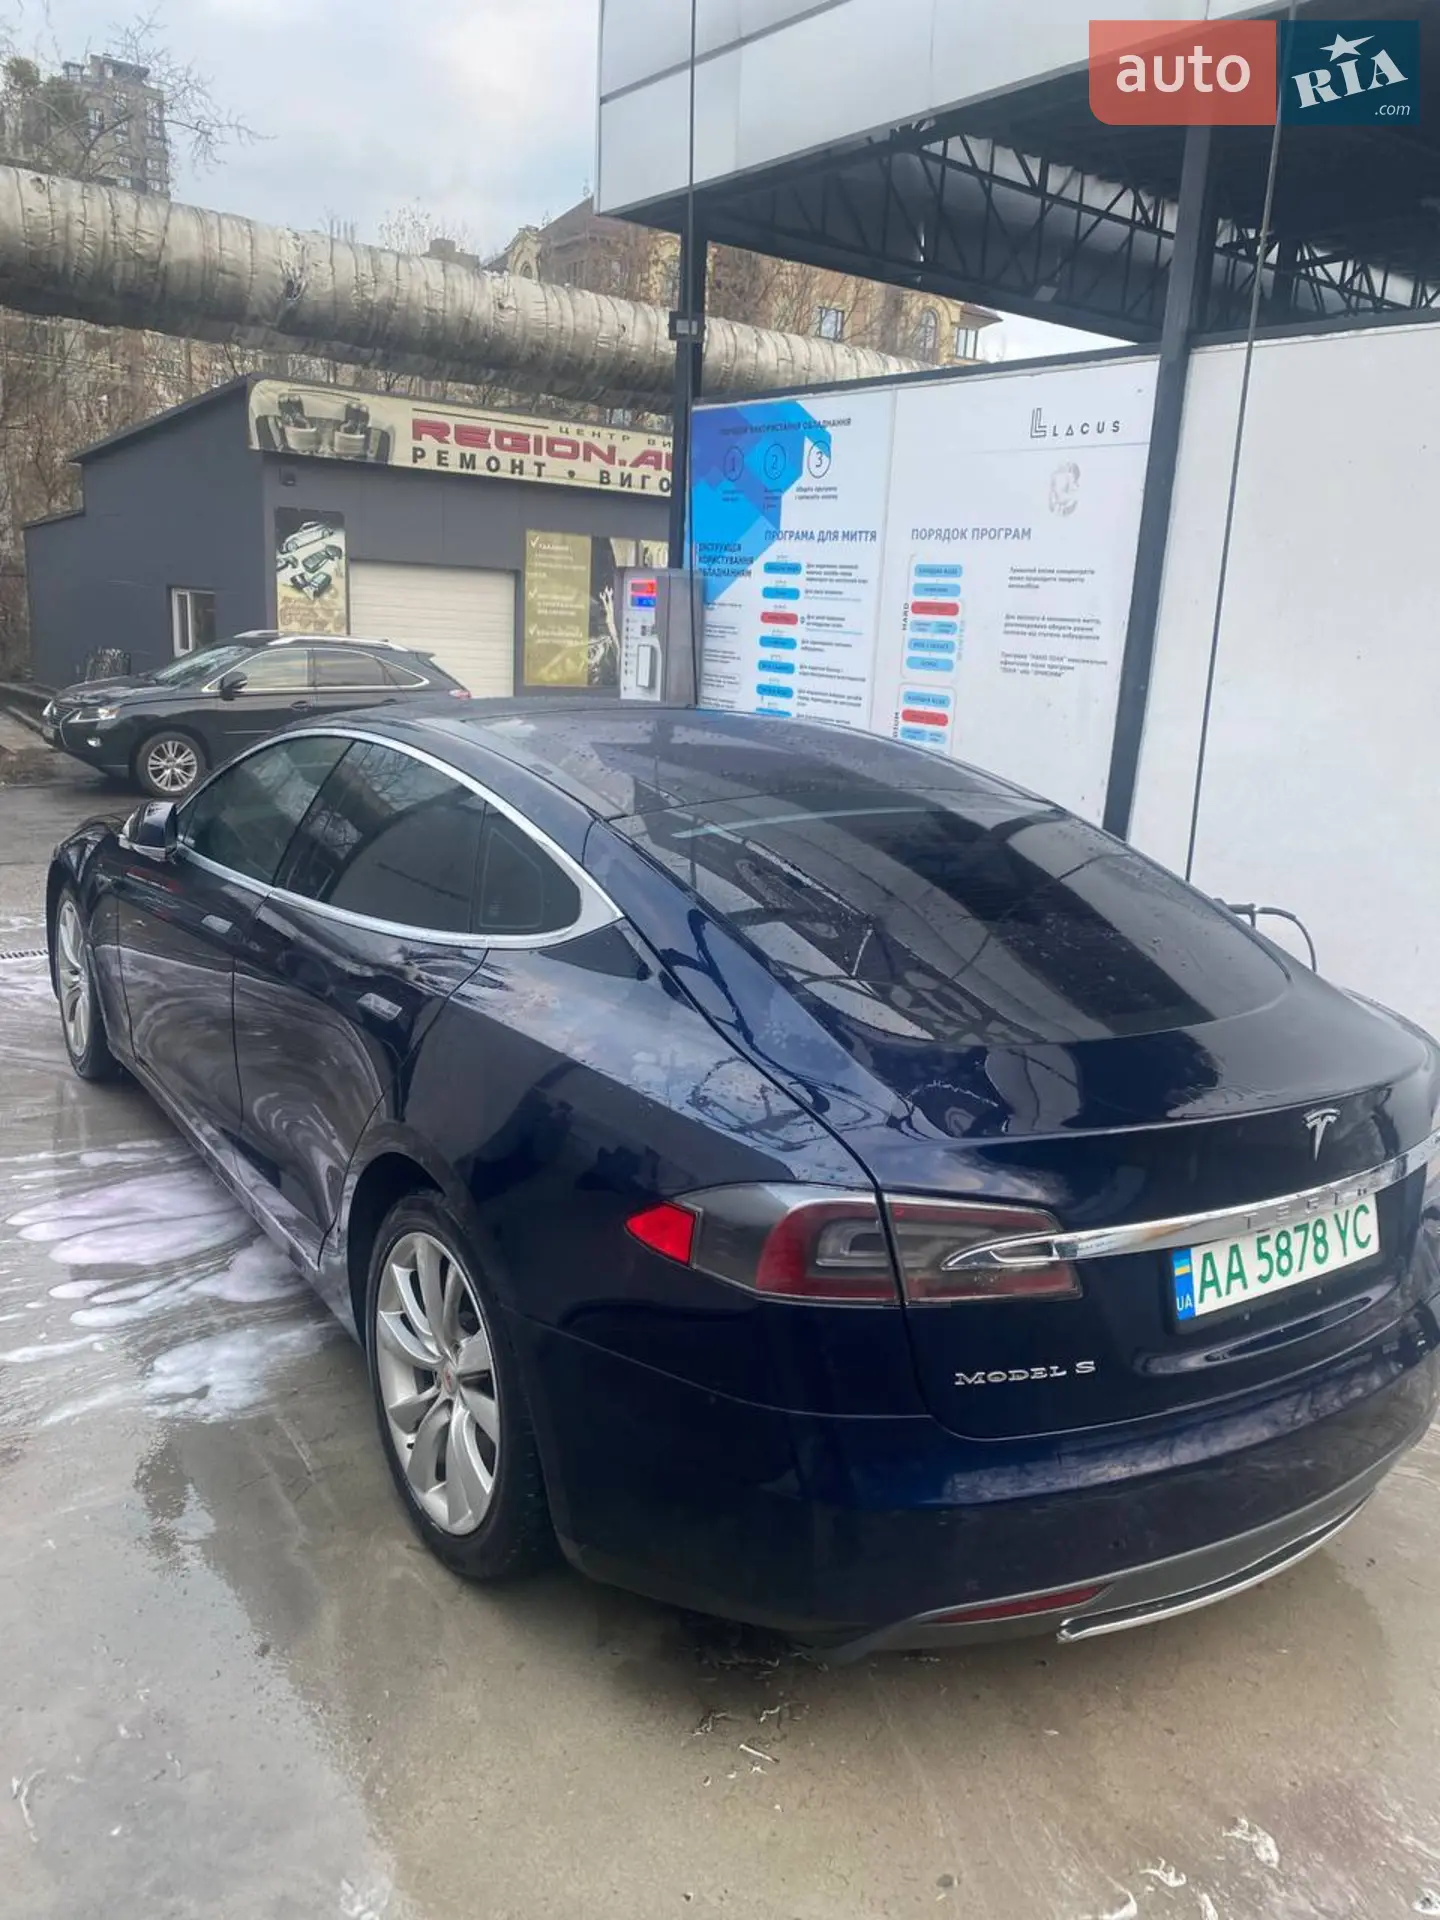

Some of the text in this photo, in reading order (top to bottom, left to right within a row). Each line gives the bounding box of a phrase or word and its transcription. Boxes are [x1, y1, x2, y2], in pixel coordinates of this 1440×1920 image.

[559, 425, 632, 442] ЦЕНТР
[412, 446, 671, 493] РЕМОНТ ВИГО
[764, 530, 877, 543] ПРОГРАМА ДЛЯ МИТТЯ
[911, 527, 1032, 545] ПОРЯДОК ПРОГРАМ
[1198, 1203, 1372, 1305] AA 5878 YC
[1176, 1292, 1194, 1312] UA
[954, 1360, 1096, 1386] MODEL S
